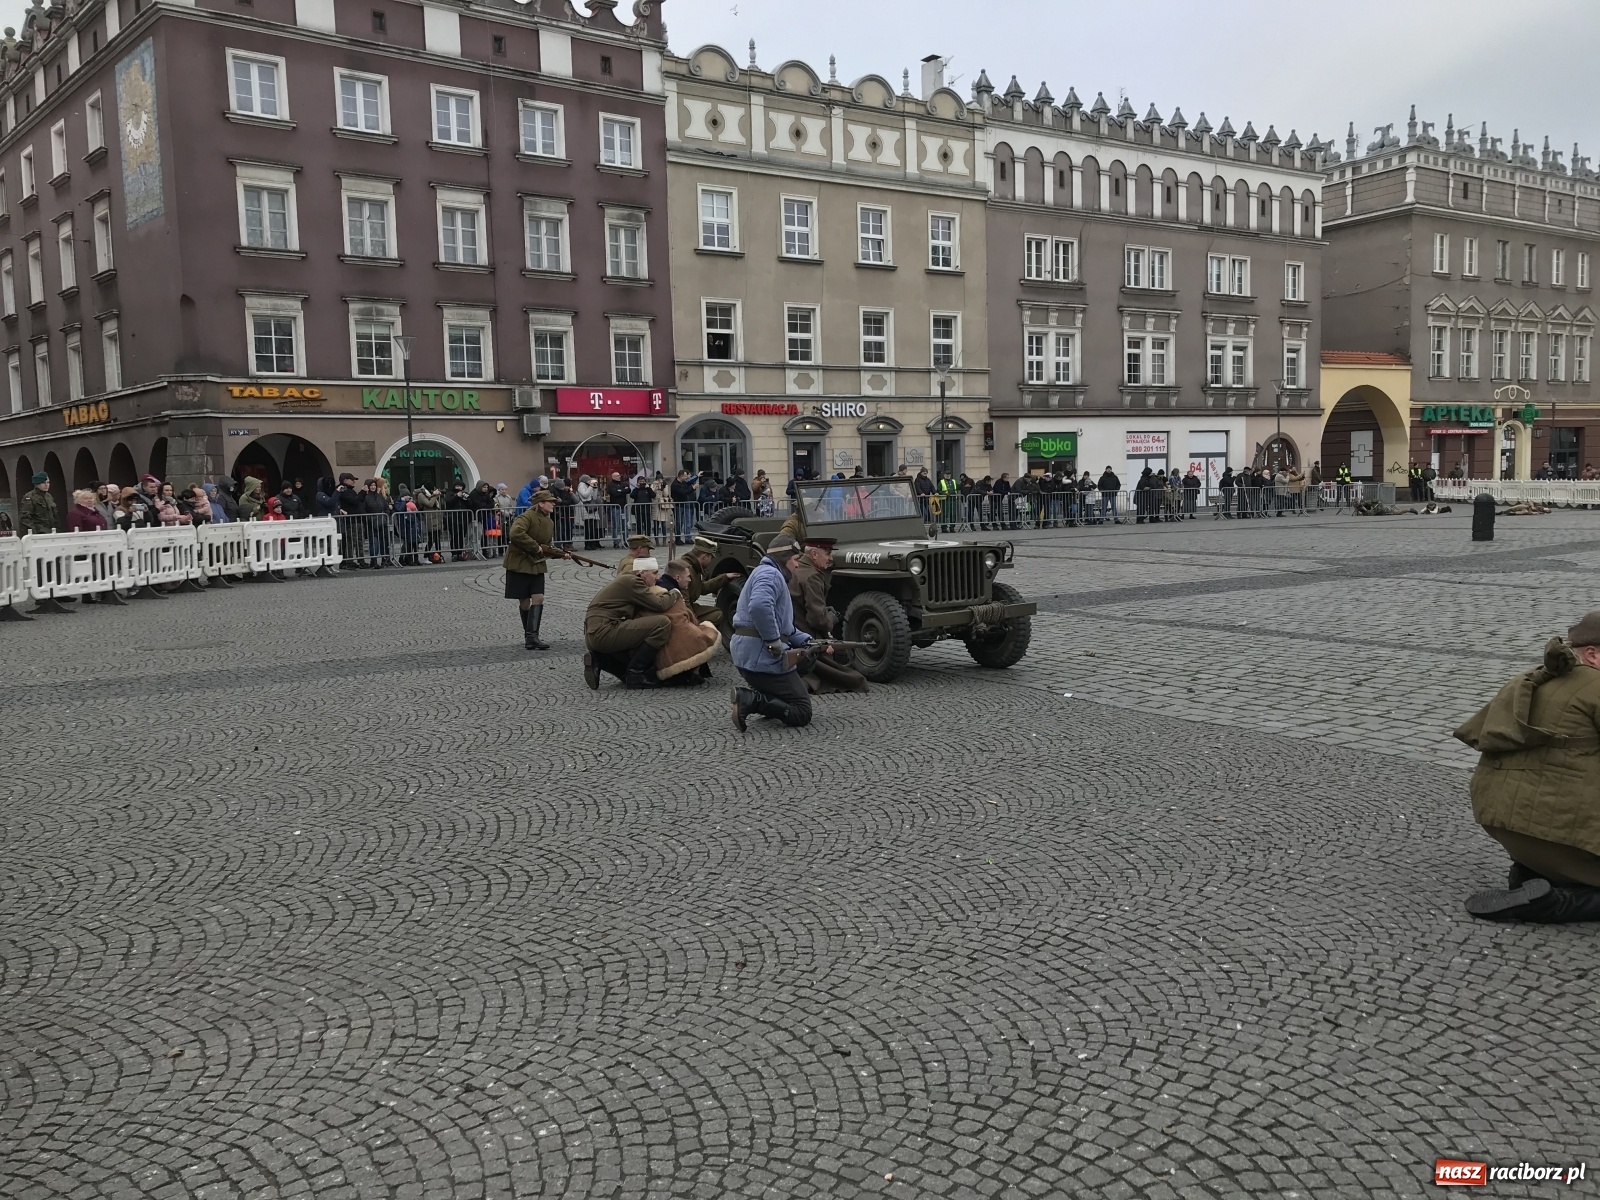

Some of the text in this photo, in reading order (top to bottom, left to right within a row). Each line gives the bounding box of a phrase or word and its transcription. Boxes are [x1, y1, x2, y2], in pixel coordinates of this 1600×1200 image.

[227, 386, 321, 399] TABAC
[362, 388, 480, 410] KANTOR
[62, 401, 111, 426] TABAC
[721, 402, 867, 417] RESTAURACJA SHIRO
[1422, 405, 1496, 421] APTEKA
